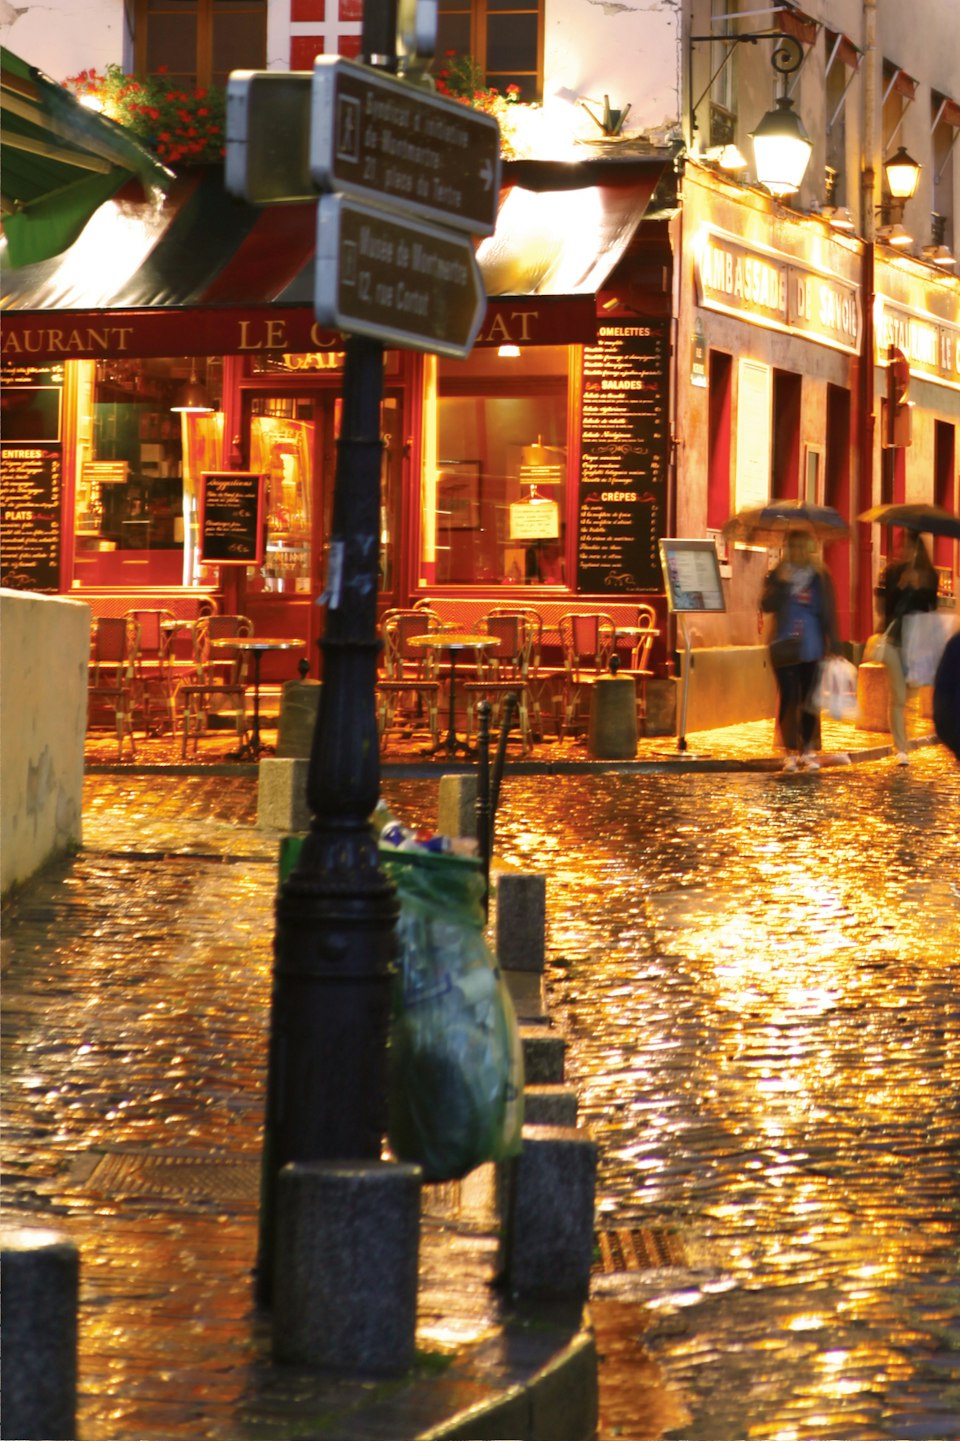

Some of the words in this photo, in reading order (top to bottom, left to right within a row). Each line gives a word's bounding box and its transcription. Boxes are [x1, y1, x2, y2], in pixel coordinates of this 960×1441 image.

[702, 243, 788, 312] AMBASSADE
[797, 276, 814, 321] DE
[819, 284, 857, 337] SAVOIE
[237, 320, 289, 351] LE
[599, 327, 651, 337] OMELETTES
[0, 328, 134, 353] AURANT
[941, 334, 952, 371] LE
[601, 380, 642, 390] SALADES
[2, 449, 42, 459] ENTREES
[601, 491, 637, 501] CRÊPES
[5, 511, 33, 520] PLATS
